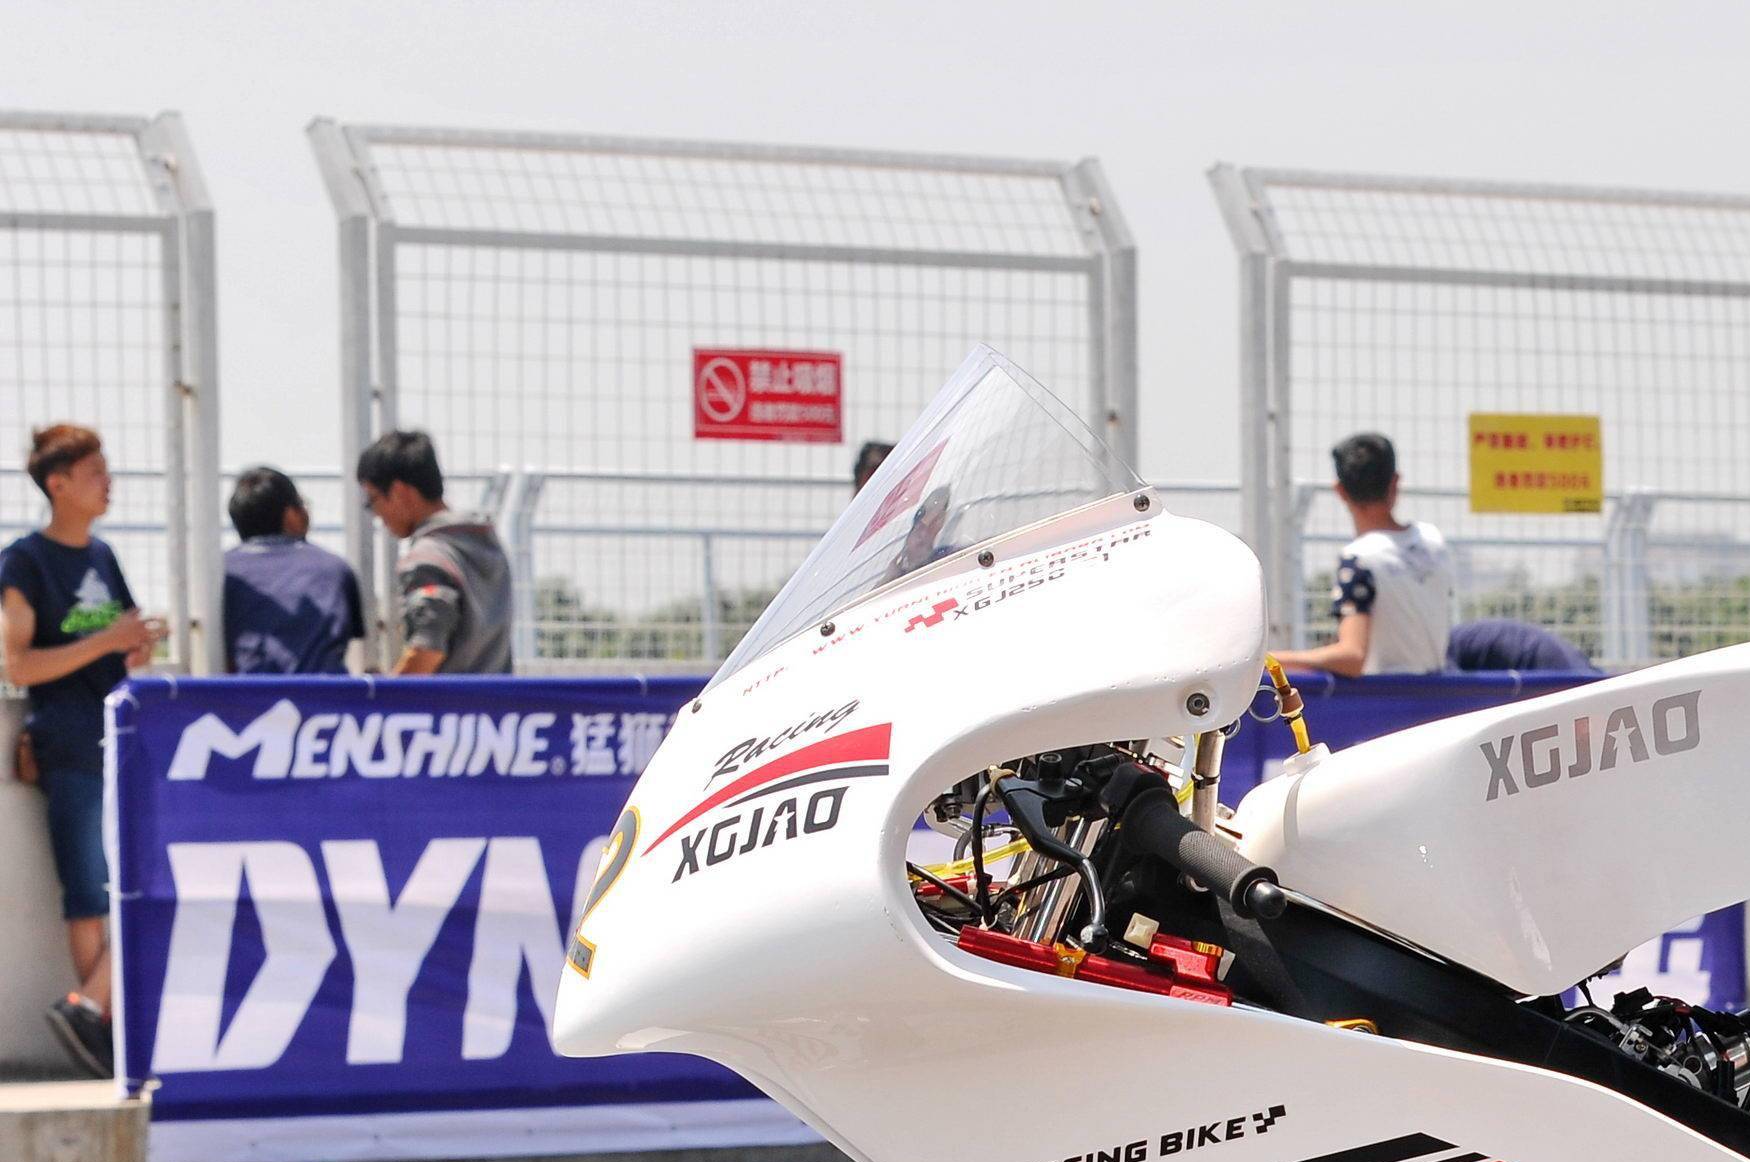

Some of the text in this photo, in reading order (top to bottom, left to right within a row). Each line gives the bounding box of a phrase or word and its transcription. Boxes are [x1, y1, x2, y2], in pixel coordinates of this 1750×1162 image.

[568, 710, 677, 777] 猛狮
[703, 698, 861, 791] Racing
[1479, 690, 1703, 802] XGJAO
[671, 785, 849, 885] XGJAO
[1159, 1115, 1247, 1157] BIKE
